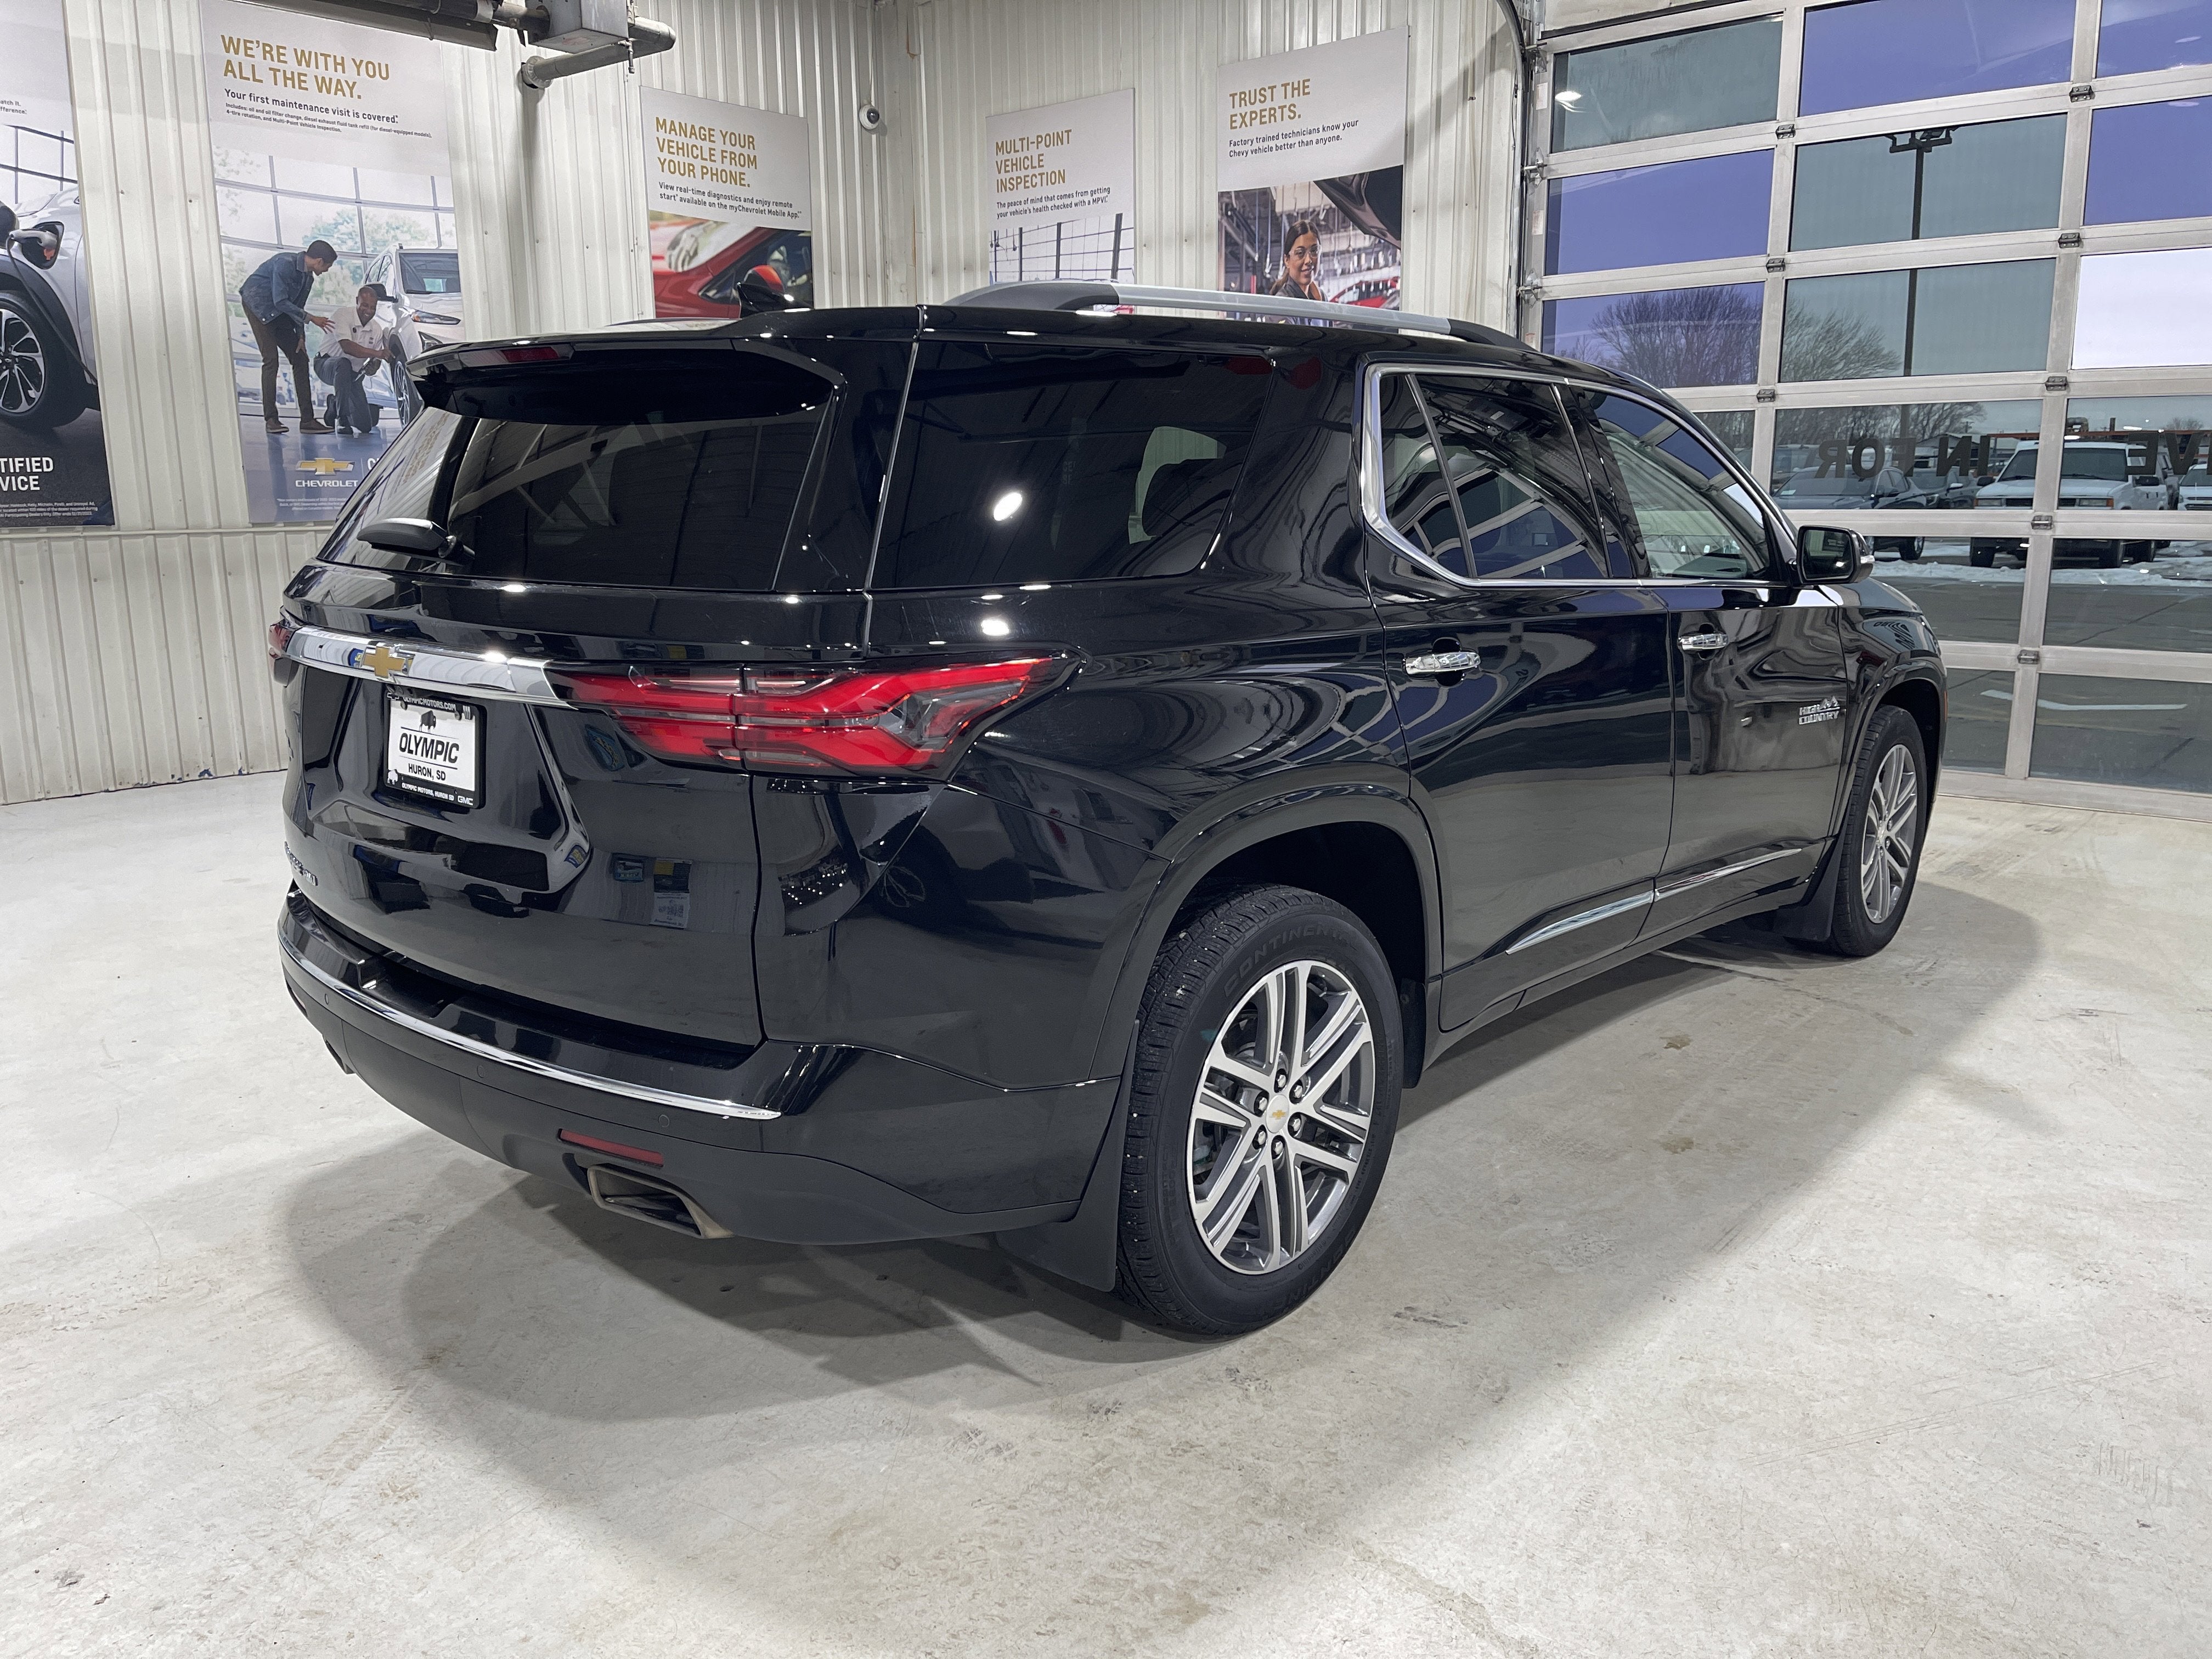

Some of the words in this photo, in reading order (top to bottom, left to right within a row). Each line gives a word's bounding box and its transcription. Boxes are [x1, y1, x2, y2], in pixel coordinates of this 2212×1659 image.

[221, 35, 287, 64] WE'RE
[294, 48, 346, 74] WITH
[351, 58, 390, 81] YOU
[223, 59, 263, 84] ALL
[269, 67, 308, 91] THE
[314, 75, 362, 99] WAY.
[224, 88, 246, 100] Your
[249, 93, 269, 104] first
[272, 99, 329, 114] maintenance
[331, 107, 350, 117] visit
[353, 110, 360, 119] is
[1229, 85, 1277, 109] TRUST
[1281, 78, 1311, 99] THE
[1229, 103, 1301, 130] EXPERTS.
[656, 117, 716, 144] MANAGE
[719, 129, 755, 150] YOUR
[995, 129, 1072, 156] MULTI-POINT
[1229, 138, 1254, 148] Factory
[1256, 132, 1279, 143] trained
[1281, 127, 1321, 139] technicians
[1322, 122, 1341, 133] know
[1342, 120, 1359, 131] your
[1229, 149, 1249, 157] Chevy
[1250, 145, 1273, 155] vehicle
[1275, 142, 1296, 151] better
[1298, 138, 1313, 148] than
[1315, 134, 1342, 145] anyone.
[656, 137, 716, 163] VEHICLE
[721, 149, 758, 170] FROM
[995, 153, 1045, 174] VEHICLE
[657, 157, 696, 179] YOUR
[701, 165, 751, 187] PHONE.
[996, 169, 1065, 193] INSPECTION
[659, 182, 674, 191] View
[676, 185, 706, 196] real-time
[707, 190, 742, 202] diagnostics
[755, 198, 771, 208] enjoy
[772, 200, 793, 208] remote
[679, 196, 707, 207] available
[729, 205, 766, 215] myChevrolet
[1007, 200, 1022, 210] peace
[1030, 196, 1043, 204] mind
[1057, 192, 1074, 200] comes
[1090, 187, 1110, 197] getting
[997, 211, 1008, 219] your
[1009, 207, 1031, 217] vehicle's
[1032, 205, 1049, 213] health
[1051, 202, 1073, 211] checked
[295, 479, 358, 488] CHEVROLET
[1799, 710, 1839, 725] COUNTRY
[399, 732, 459, 764] OLYMPIC
[409, 763, 435, 780] HURON,
[436, 770, 446, 781] SD
[402, 782, 417, 791] OLYMPIC
[435, 791, 448, 799] HURON
[458, 795, 473, 805] GMC
